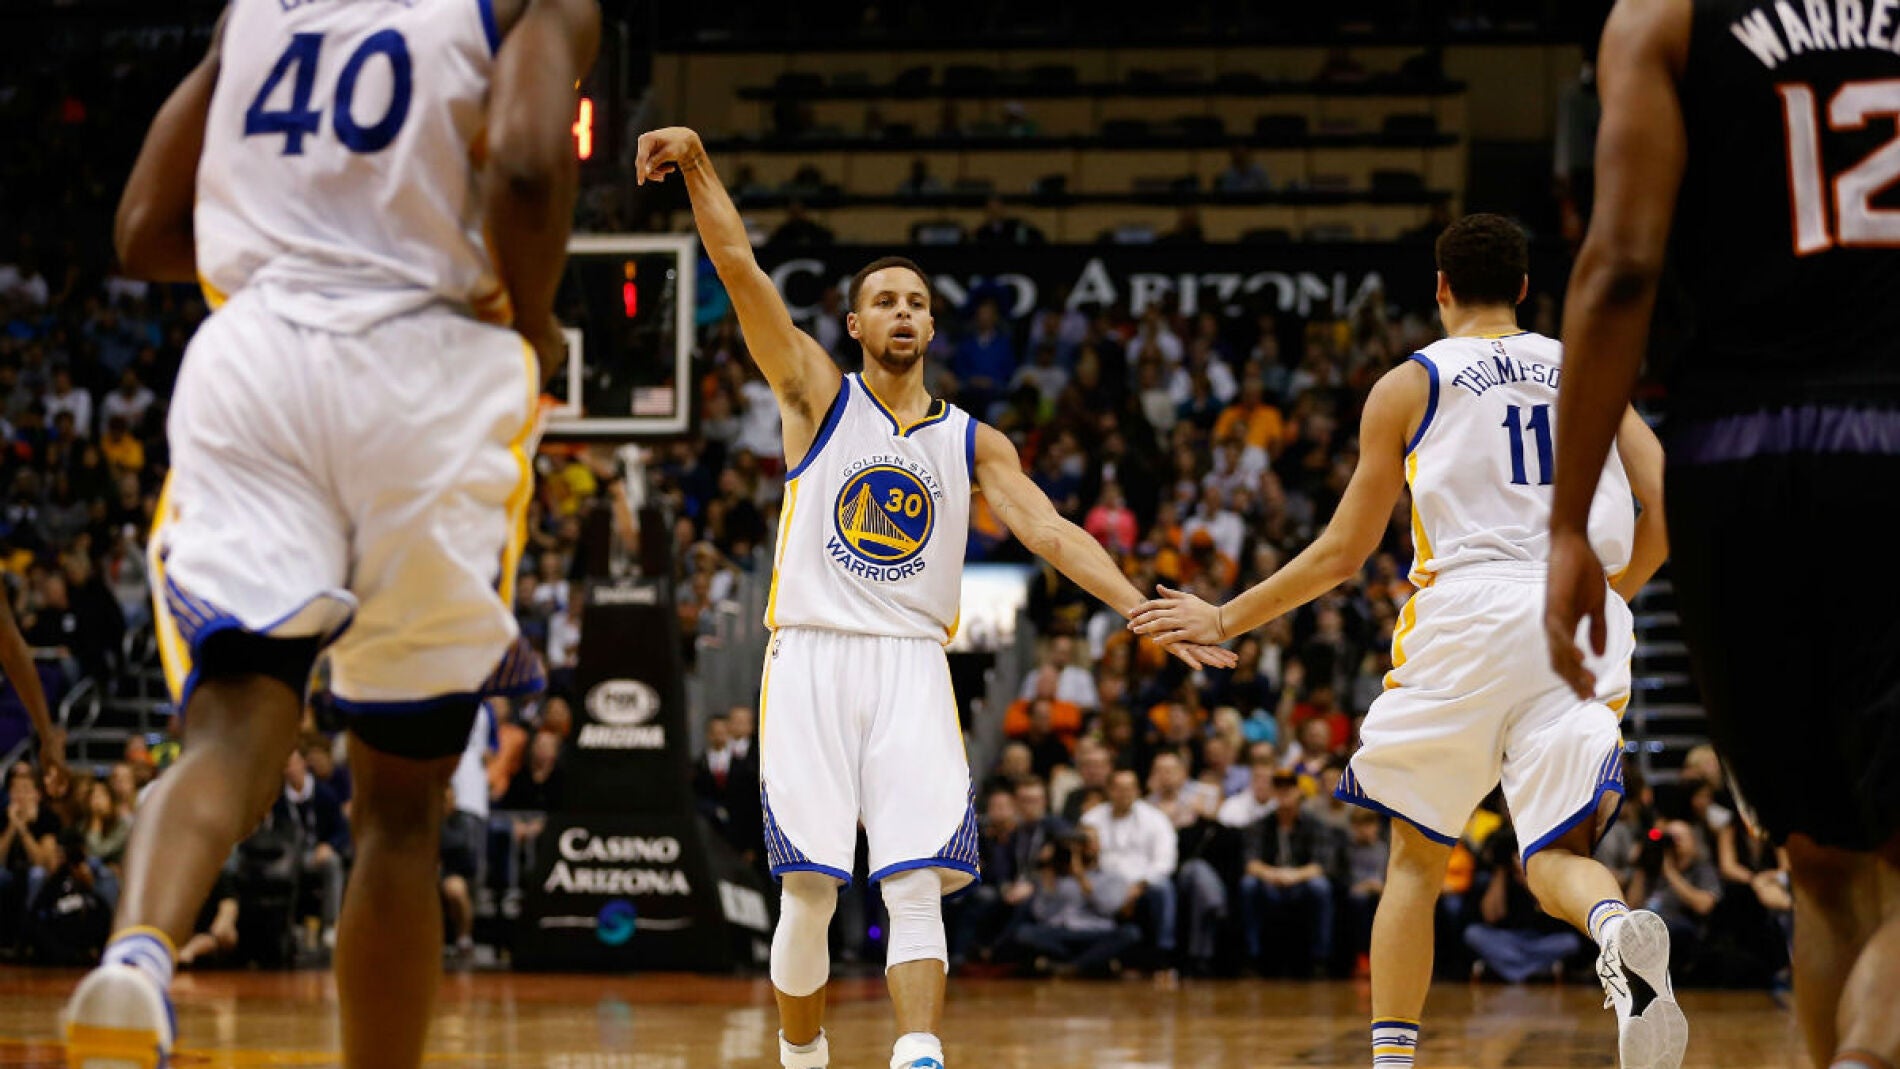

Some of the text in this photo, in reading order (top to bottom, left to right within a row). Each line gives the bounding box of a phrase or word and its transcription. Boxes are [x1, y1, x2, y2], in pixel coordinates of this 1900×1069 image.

[1729, 0, 1900, 69] WARRE
[244, 29, 413, 155] 40
[1774, 78, 1900, 257] 12
[1452, 355, 1561, 397] THOMPSO
[1502, 403, 1555, 485] 11
[843, 455, 942, 501] GOLDEN STATE
[884, 487, 923, 518] 30
[826, 535, 925, 581] WARRIORS
[559, 827, 681, 863] CASINO
[544, 859, 692, 896] ARIZONA
